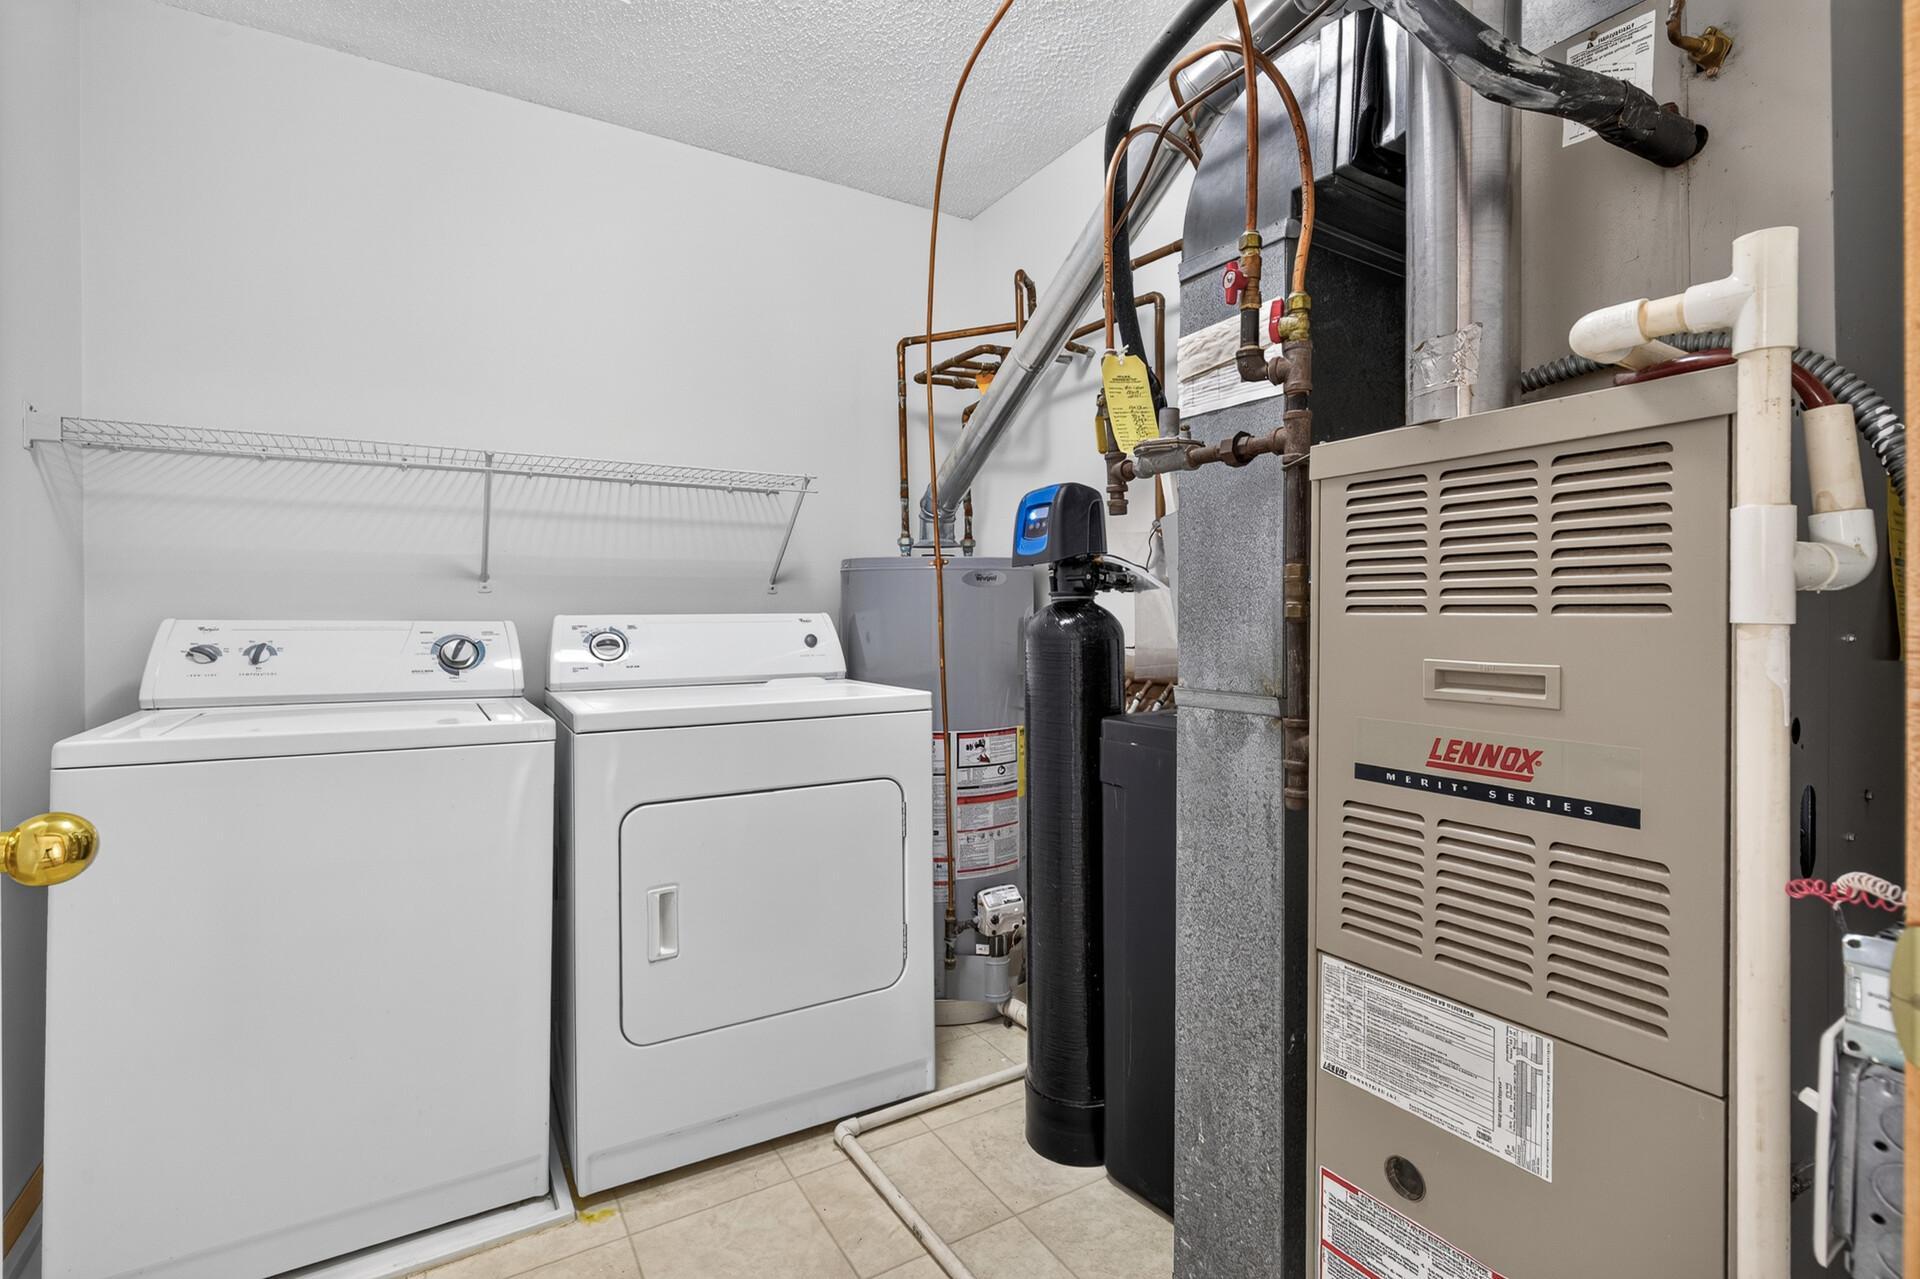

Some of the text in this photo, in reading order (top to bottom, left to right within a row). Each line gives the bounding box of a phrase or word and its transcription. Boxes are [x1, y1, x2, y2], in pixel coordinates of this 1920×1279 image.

[1429, 737, 1543, 774] LENNOX
[1386, 771, 1594, 816] MERIT SERIES
